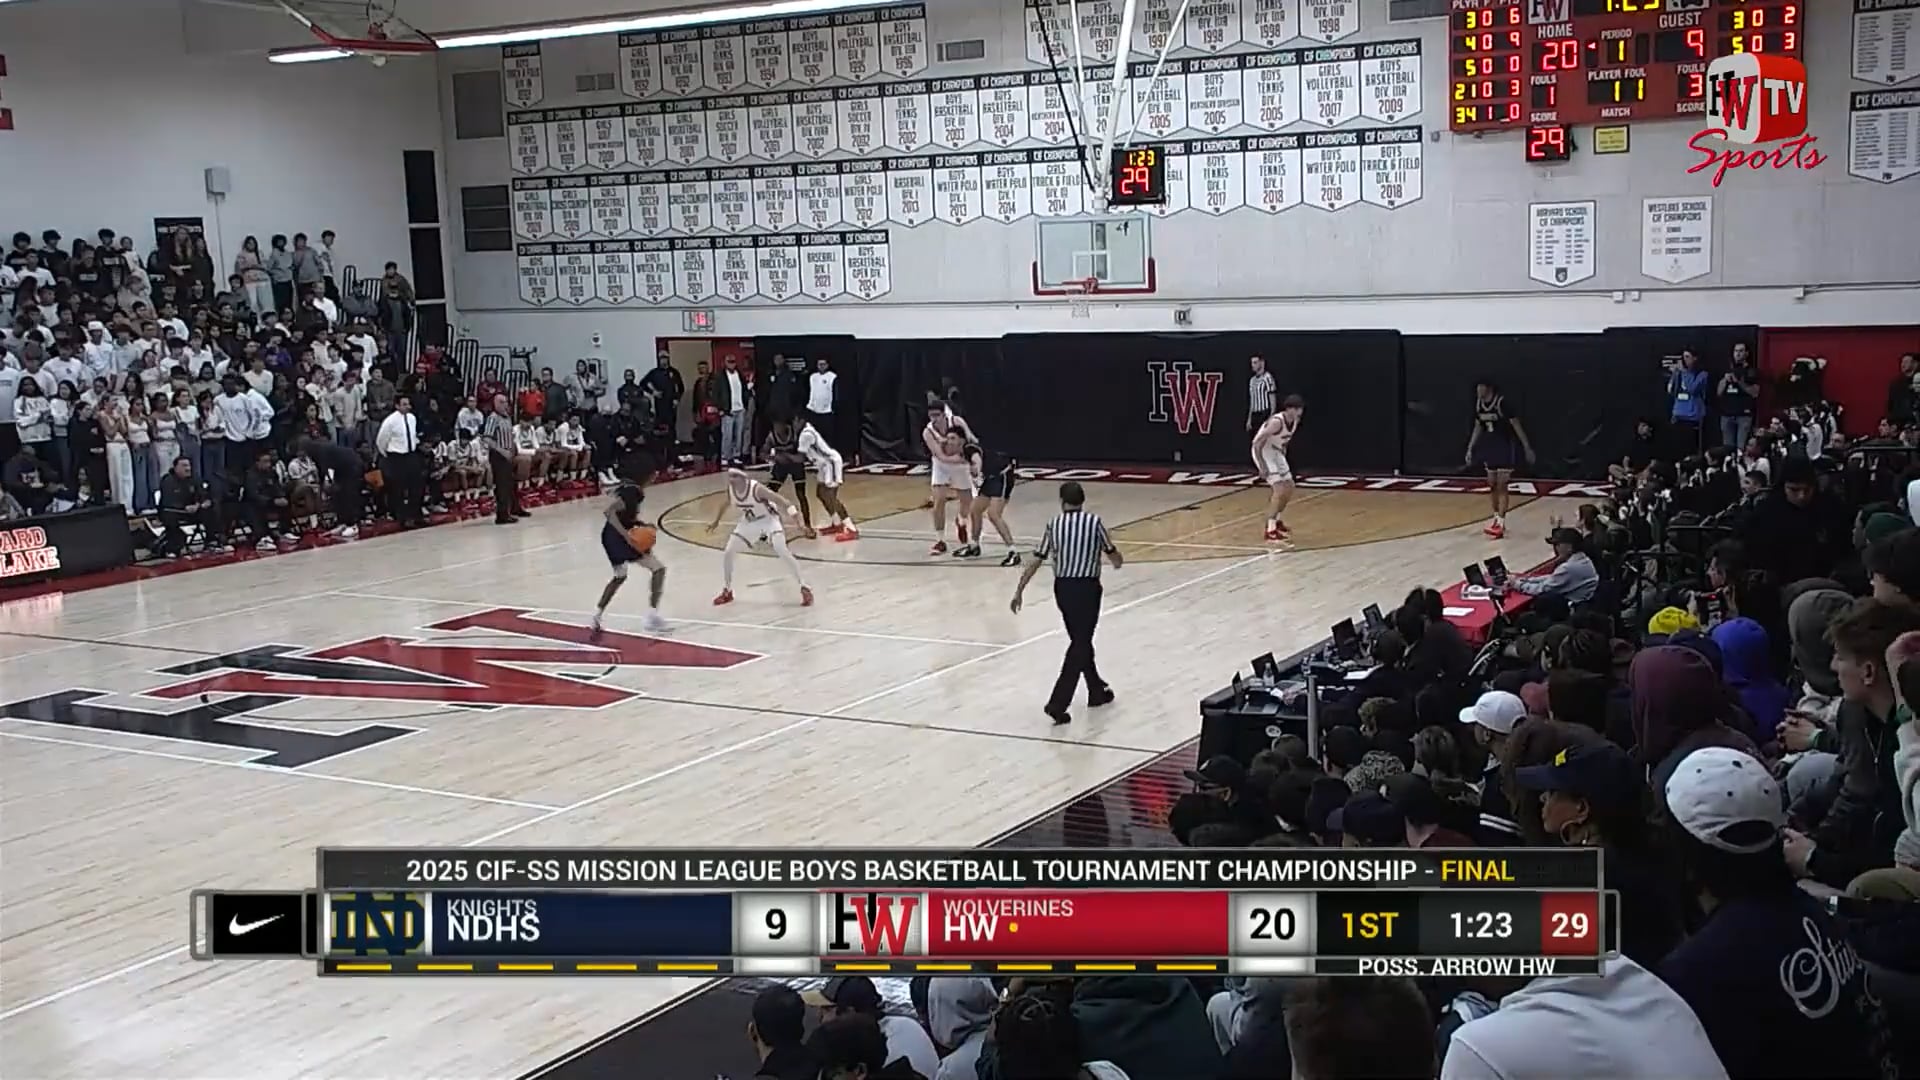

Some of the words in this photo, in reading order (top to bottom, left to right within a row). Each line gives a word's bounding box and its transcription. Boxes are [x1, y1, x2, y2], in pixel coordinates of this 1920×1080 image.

[1189, 1, 1236, 19] BASKETBALL
[1467, 11, 1476, 28] 3
[1482, 10, 1492, 26] 0
[1510, 8, 1519, 24] 6
[1659, 12, 1702, 28] GUEST
[1734, 10, 1744, 29] 3
[1752, 9, 1763, 27] 0
[1784, 6, 1795, 24] 2
[1260, 24, 1281, 38] 1998
[1318, 18, 1340, 33] 1998
[1538, 24, 1573, 39] HOME
[1203, 29, 1224, 44] 1998
[1466, 36, 1476, 50] 4
[1482, 34, 1492, 50] 0
[1510, 32, 1520, 46] 9
[1601, 29, 1632, 39] PERIOD
[1687, 29, 1703, 57] 9
[1732, 36, 1744, 54] 5
[1752, 35, 1762, 52] 0
[1784, 32, 1795, 49] 3
[1542, 40, 1577, 70] 20
[1619, 40, 1624, 61] 1
[1319, 64, 1341, 76] GIRLS
[1380, 60, 1401, 72] BOYS
[1466, 59, 1476, 76] 5
[1482, 58, 1492, 74] 0
[1510, 56, 1519, 72] 0
[1677, 63, 1706, 74] FOULS
[1205, 74, 1224, 85] BOYS
[1261, 69, 1281, 81] BOYS
[1366, 72, 1415, 86] BASKETBALL
[1530, 75, 1556, 85] FOULS
[1588, 70, 1622, 81] PLAYER
[1624, 68, 1646, 78] FOUL
[1257, 81, 1284, 94] TENNIS
[1306, 76, 1353, 90] VOLLEYBALL
[1455, 84, 1476, 100] 21
[1483, 82, 1492, 97] 0
[1511, 80, 1519, 96] 3
[1690, 74, 1703, 96] 3
[1205, 86, 1222, 98] GOLF
[1550, 86, 1554, 105] 1
[935, 104, 973, 116] BASKETBALL
[1320, 103, 1341, 117] 2007
[1379, 99, 1403, 114] 2009
[1456, 107, 1476, 123] 34
[1488, 106, 1492, 120] 1
[1510, 103, 1519, 119] 0
[1601, 107, 1630, 117] MATCH
[1677, 102, 1705, 112] SCORE
[1204, 111, 1226, 125] 2005
[1260, 107, 1283, 122] 2005
[1531, 112, 1557, 122] SCORE
[994, 125, 1014, 138] 2004
[1531, 128, 1564, 157] 29
[1129, 150, 1154, 166] 1:23
[1263, 152, 1282, 164] BOYS
[1321, 149, 1341, 160] BOYS
[1381, 146, 1402, 158] BOYS
[1207, 155, 1225, 167] BOYS
[1306, 161, 1332, 174] WATER
[1336, 160, 1356, 172] POLO
[1362, 159, 1387, 171] TRACK
[1399, 158, 1419, 169] FIELD
[1204, 168, 1229, 180] TENNIS
[1260, 164, 1286, 176] TENNIS
[1394, 172, 1406, 182] III
[1122, 167, 1149, 194] 29
[1207, 192, 1226, 206] 2017
[1264, 190, 1284, 203] 2018
[1321, 188, 1342, 201] 2018
[1381, 185, 1402, 199] 2018
[902, 201, 919, 213] 2013
[999, 202, 1016, 215] 2014
[1682, 202, 1707, 211] SCHOOL
[1147, 362, 1223, 434] HW
